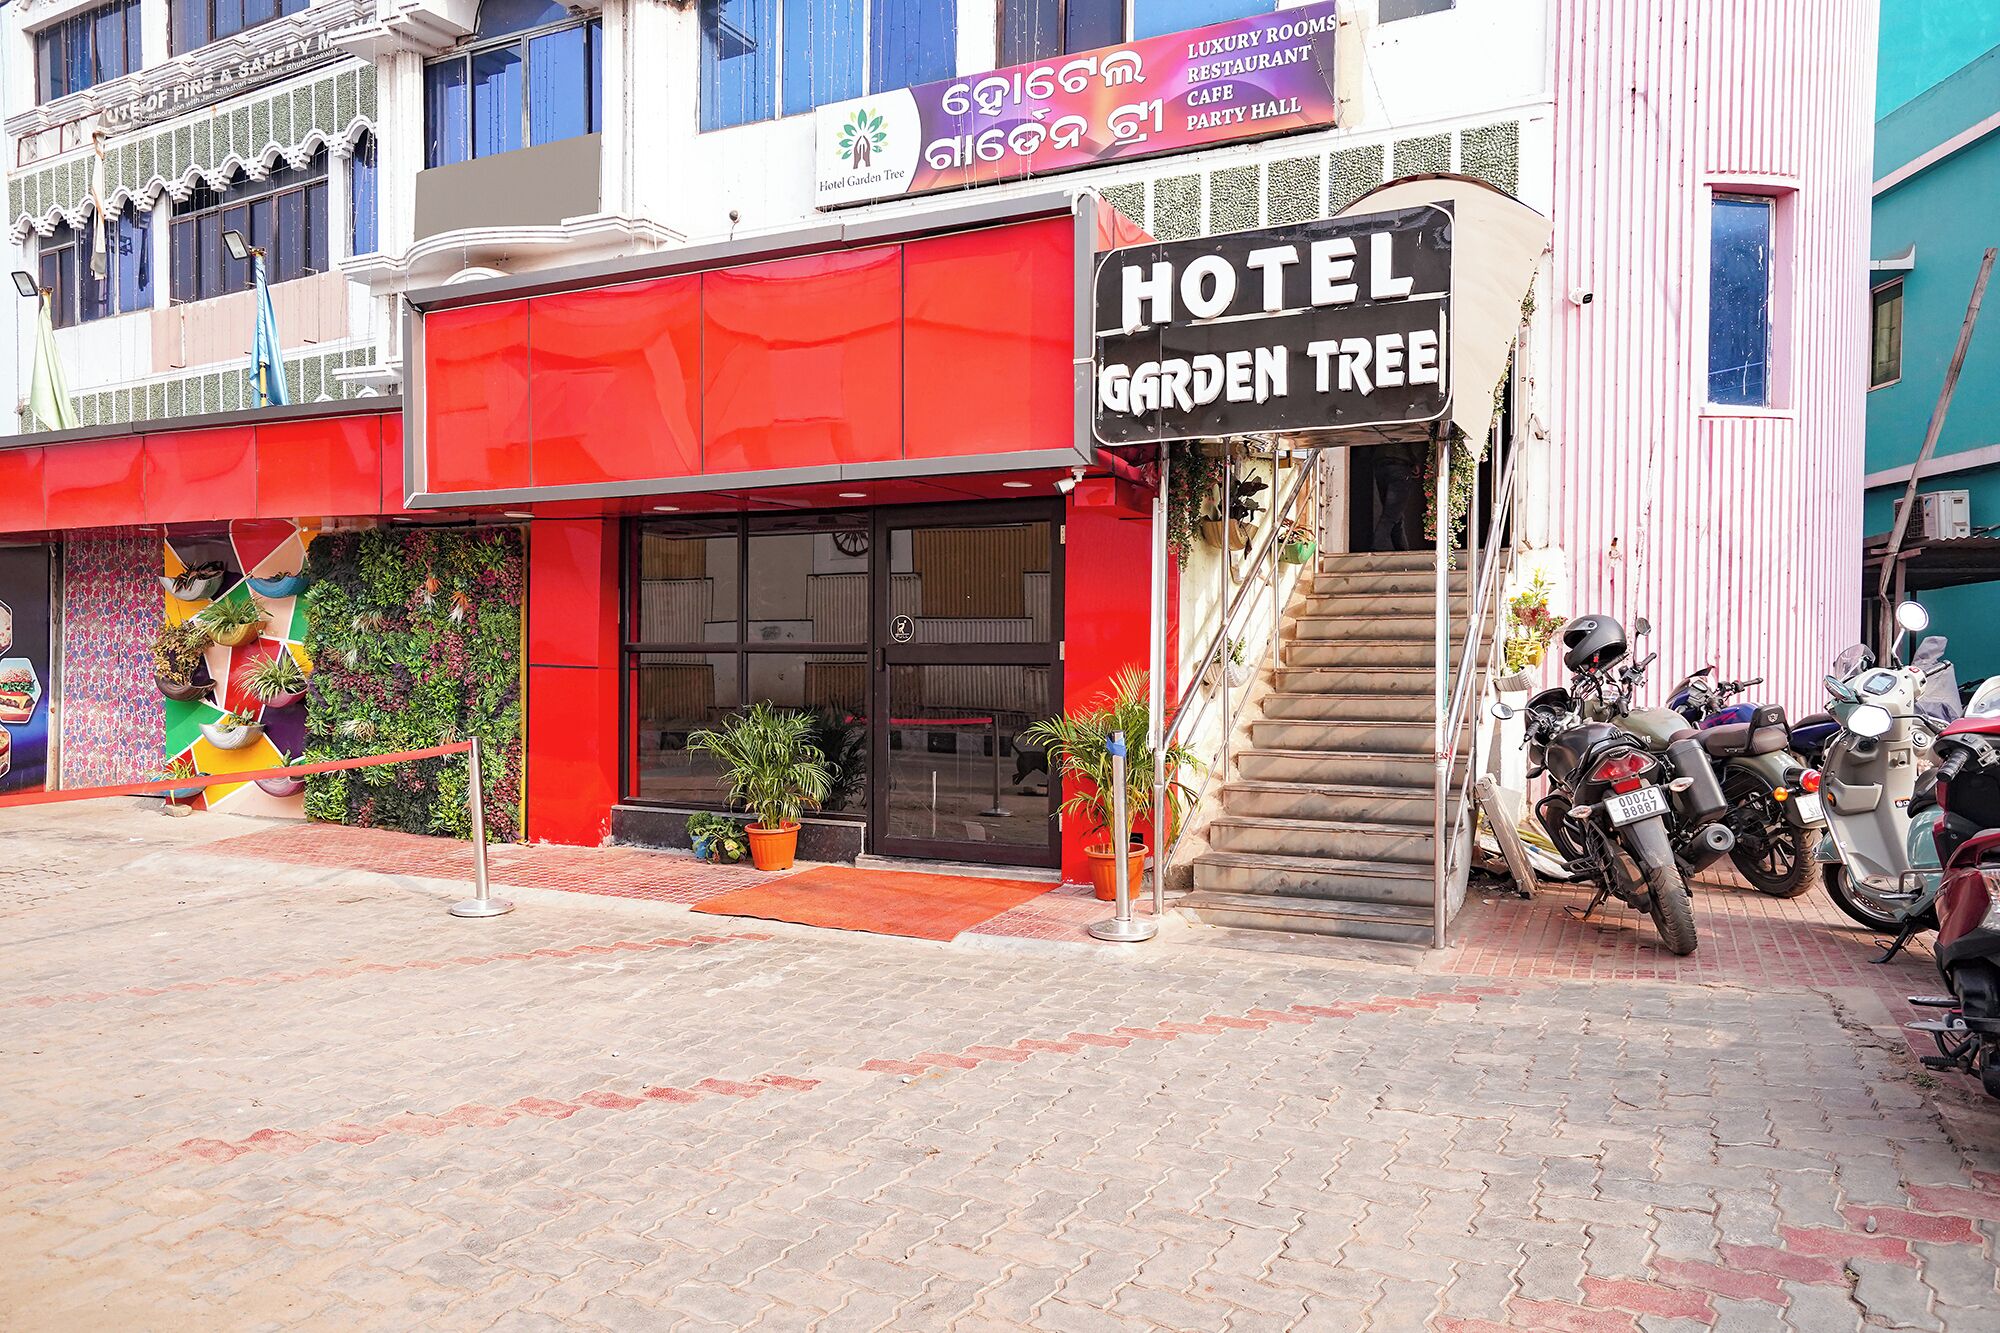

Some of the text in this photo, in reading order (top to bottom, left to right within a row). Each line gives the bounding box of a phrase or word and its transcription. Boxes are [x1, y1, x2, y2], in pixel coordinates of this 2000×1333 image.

[1188, 13, 1337, 59] LUXURY ROOMS
[147, 89, 168, 112] OF
[174, 75, 214, 103] FIRE
[239, 39, 311, 78] SAFETY
[942, 50, 1146, 117] ହୋଟେଲ
[1187, 44, 1311, 83] RESTAURANT
[1187, 84, 1233, 106] CAFE
[1187, 97, 1302, 131] PARTY HALL
[820, 169, 905, 191] Hotel Garden Tree
[1122, 232, 1414, 336] HOTEL
[1100, 329, 1438, 417] GARDEN TREE
[1622, 800, 1657, 818] B8887
